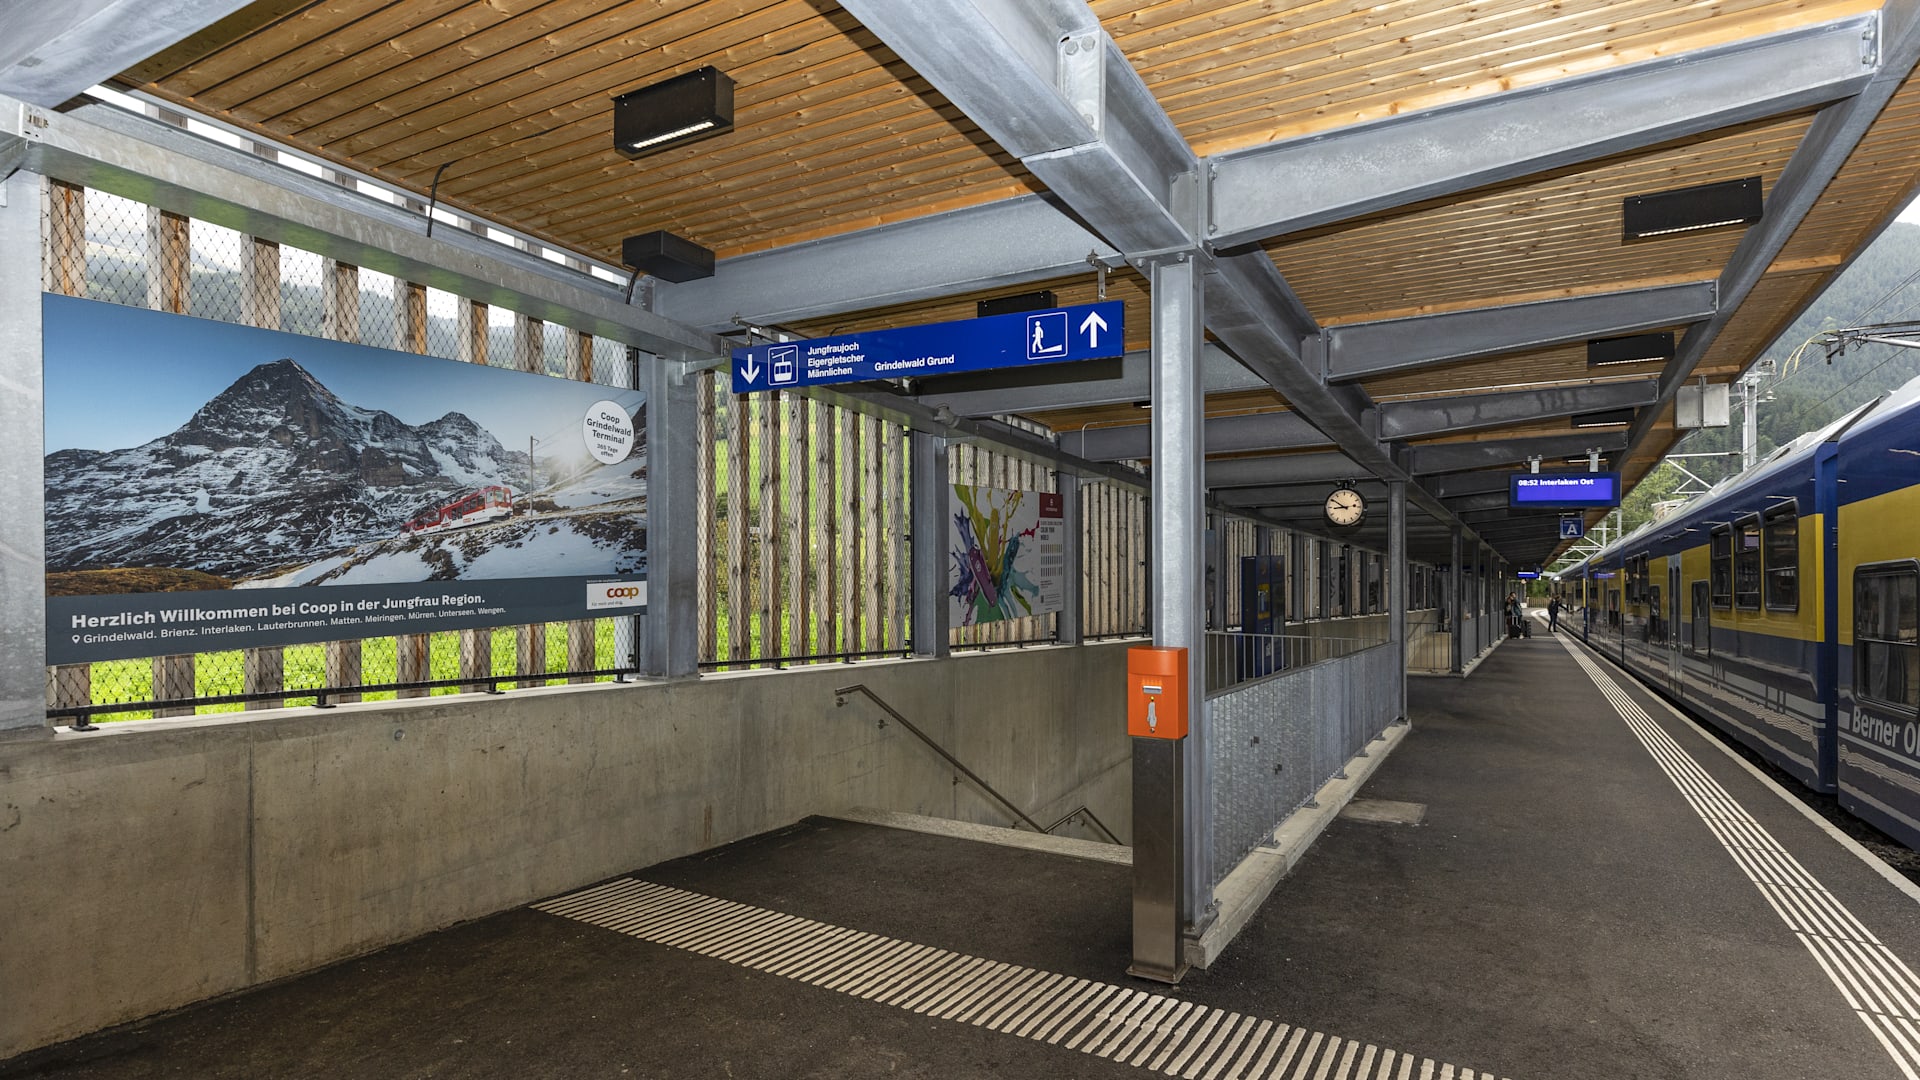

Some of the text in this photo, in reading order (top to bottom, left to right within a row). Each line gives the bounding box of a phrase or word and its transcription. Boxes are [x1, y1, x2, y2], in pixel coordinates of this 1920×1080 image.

[807, 342, 860, 356] Jungfraujoch
[807, 354, 865, 368] Eigergletscher
[874, 354, 955, 371] Grindelwald Grund
[807, 367, 853, 379] Männlichen
[600, 411, 621, 425] Coop
[586, 418, 632, 437] Grindelwald
[592, 429, 625, 445] Terminal
[1518, 479, 1539, 487] 08:52
[1567, 524, 1578, 535] A
[606, 586, 640, 600] coop
[71, 593, 486, 629] Herzlich Willkommen bei Coop in der Jungfrau Region.
[83, 607, 507, 644] Grindelwald. Brienz. Interlaken. Lauterbrunnen. Matten. Meiringen. Mürren. Unterseen. Wengen.
[1852, 705, 1900, 748] Berner
